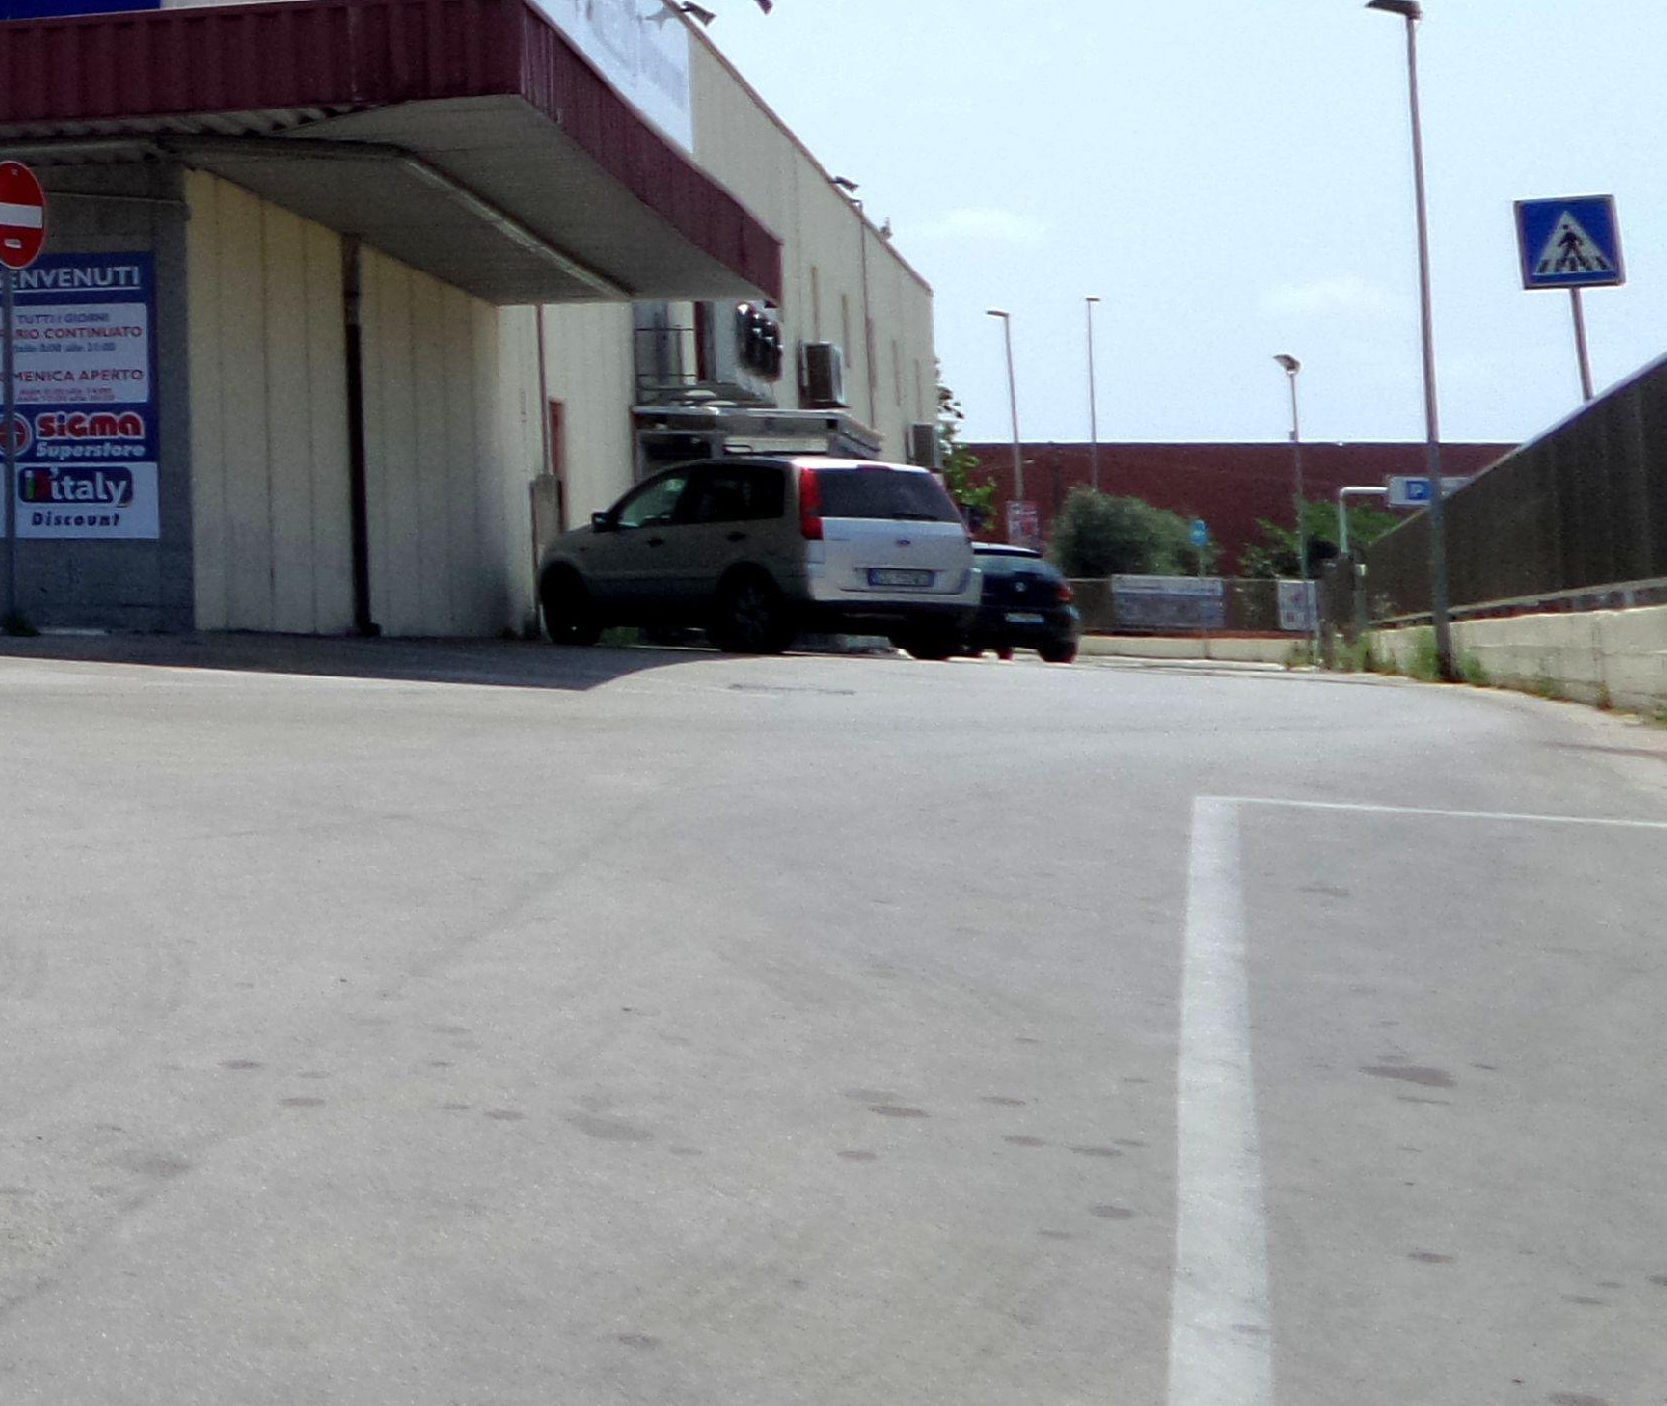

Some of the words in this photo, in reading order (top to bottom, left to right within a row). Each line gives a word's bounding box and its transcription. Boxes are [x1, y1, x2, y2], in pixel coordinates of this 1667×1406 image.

[44, 326, 142, 340] CONTINUATO
[79, 369, 144, 381] APERTO
[36, 441, 146, 461] Superstore
[32, 511, 120, 526] Discount
